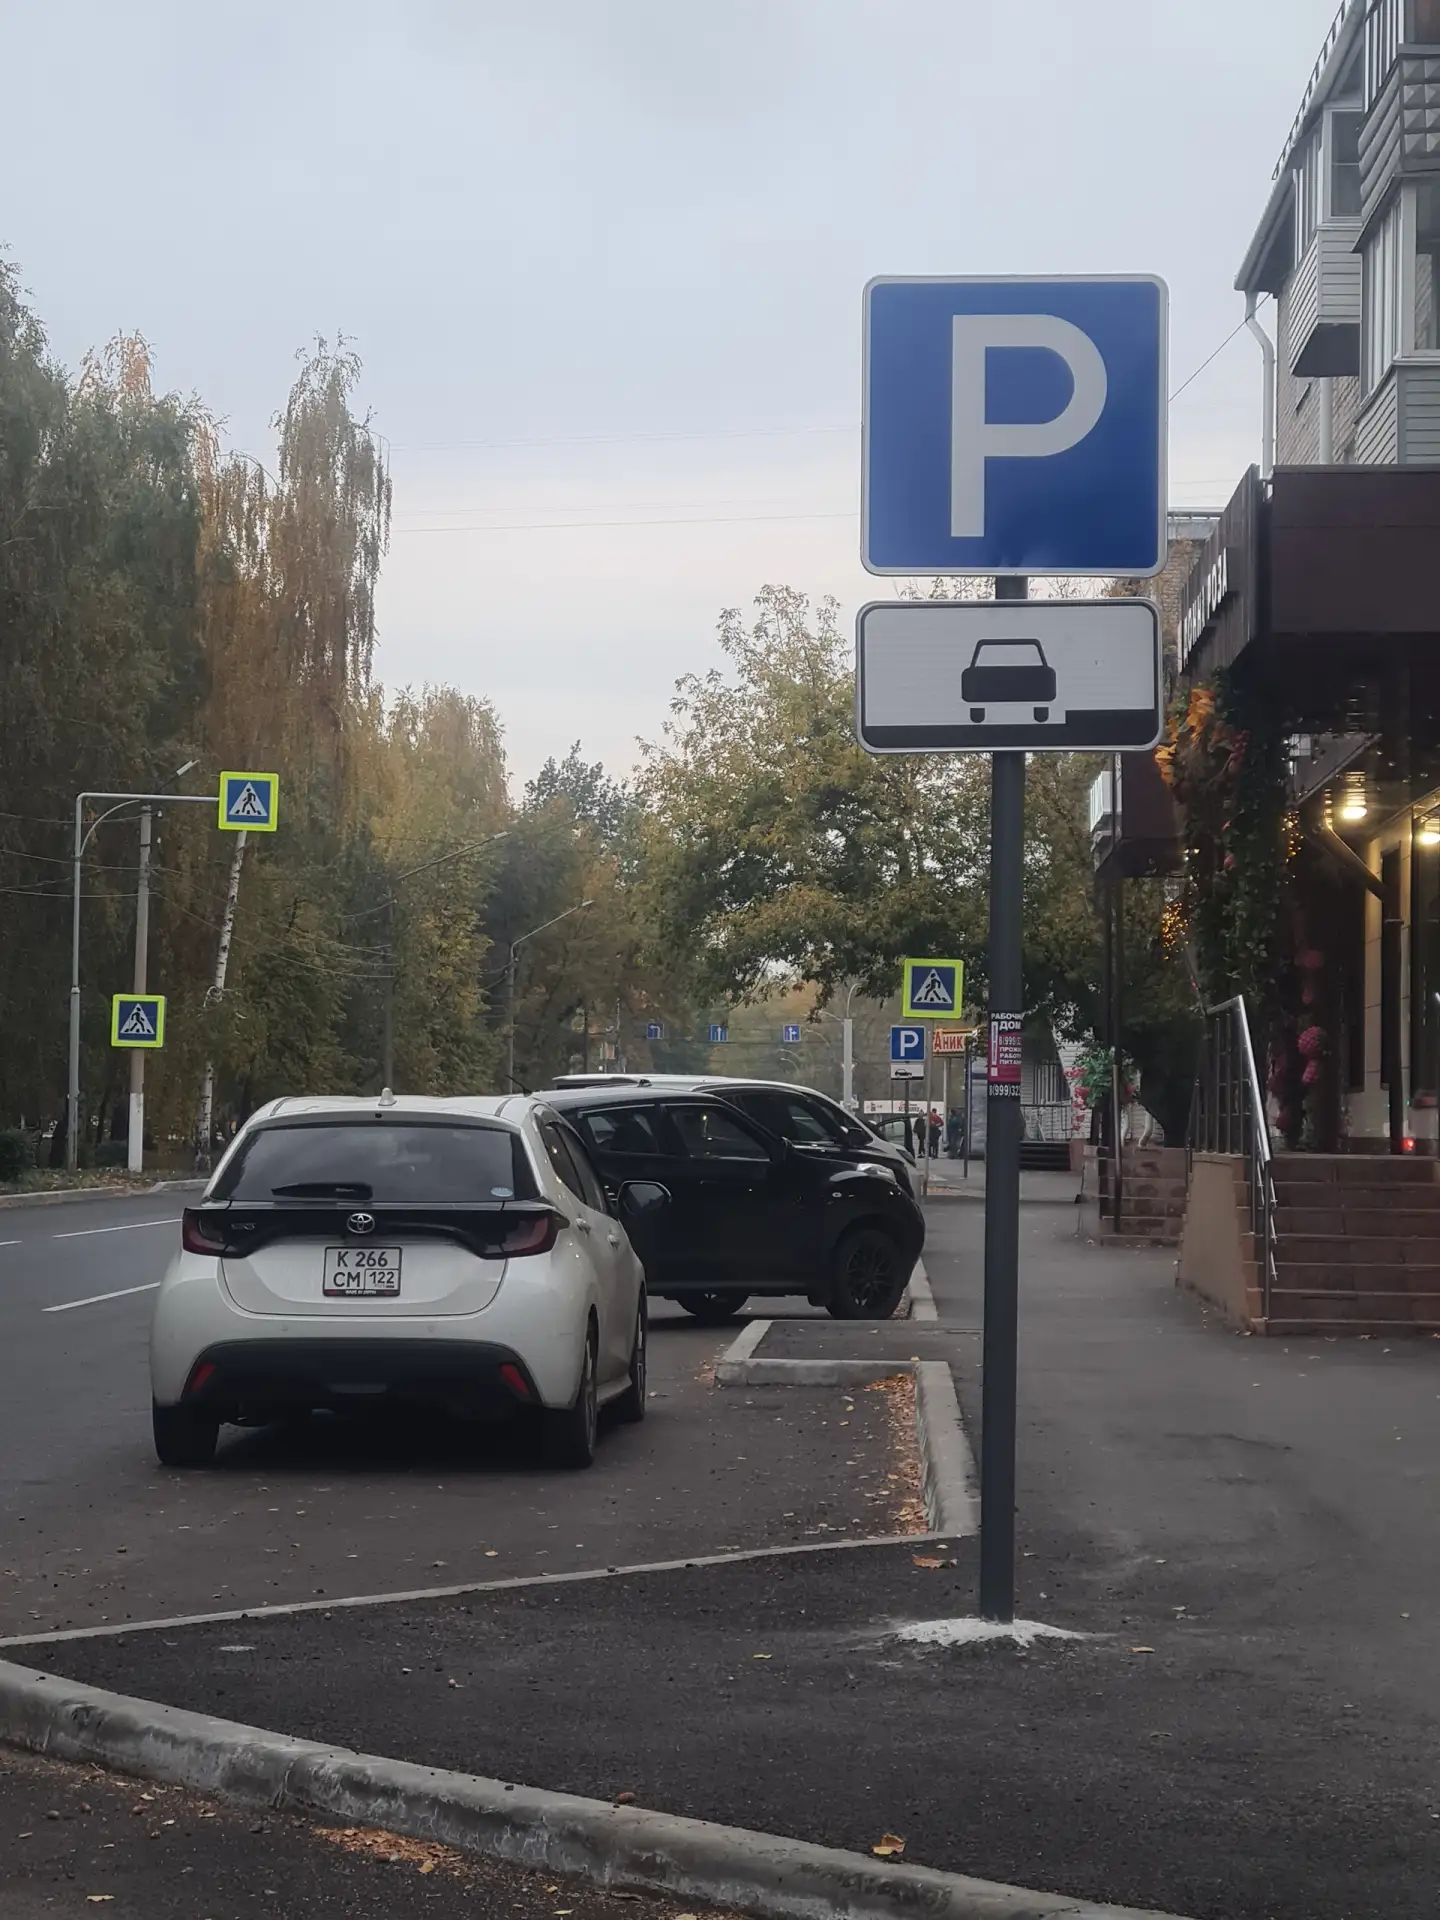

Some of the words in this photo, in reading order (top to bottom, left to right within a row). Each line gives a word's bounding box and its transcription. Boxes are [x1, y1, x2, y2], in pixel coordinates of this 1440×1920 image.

[950, 314, 1108, 538] P
[1207, 546, 1228, 621] РОЗА
[899, 1030, 920, 1057] P
[988, 1084, 1021, 1097] 8(999)32
[355, 1251, 388, 1267] 266
[333, 1271, 361, 1288] СМ
[369, 1271, 395, 1284] 122
